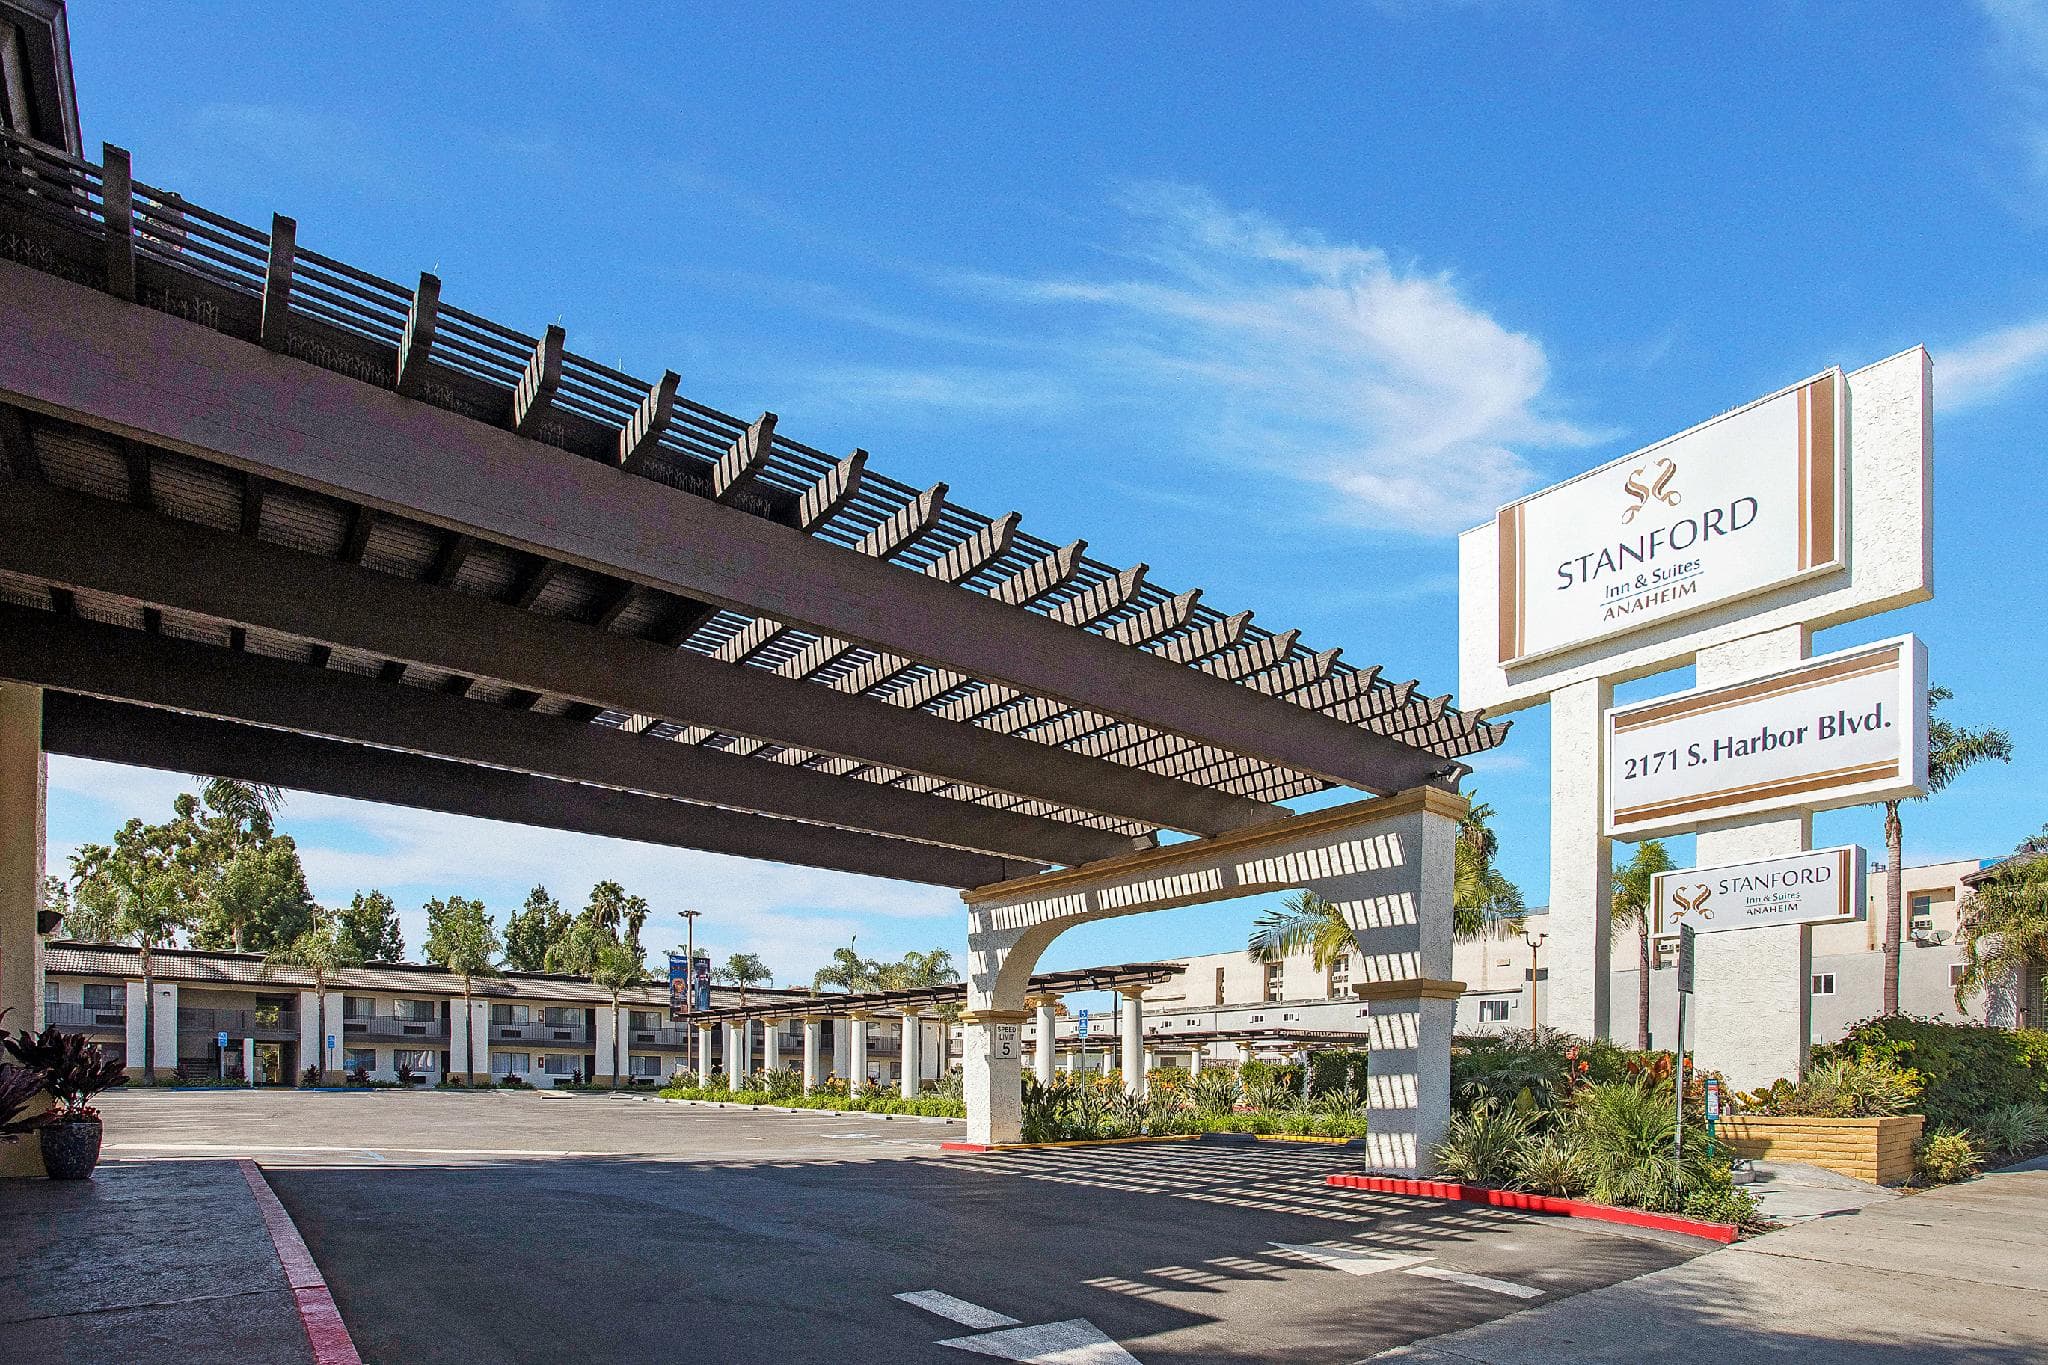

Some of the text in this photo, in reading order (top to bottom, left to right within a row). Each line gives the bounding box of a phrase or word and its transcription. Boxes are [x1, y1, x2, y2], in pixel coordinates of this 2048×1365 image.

[1557, 496, 1758, 590] STANFORD
[1605, 558, 1701, 598] Inn & Suites
[1603, 580, 1697, 621] ANAHEIM
[1624, 702, 1892, 780] 2171 S. Harbor Blvd.
[1719, 866, 1831, 895] STANFORD
[1746, 895, 1761, 905] Inn
[1773, 891, 1800, 901] Suites
[1746, 903, 1798, 916] ANAHEIM
[1002, 1042, 1011, 1056] 5
